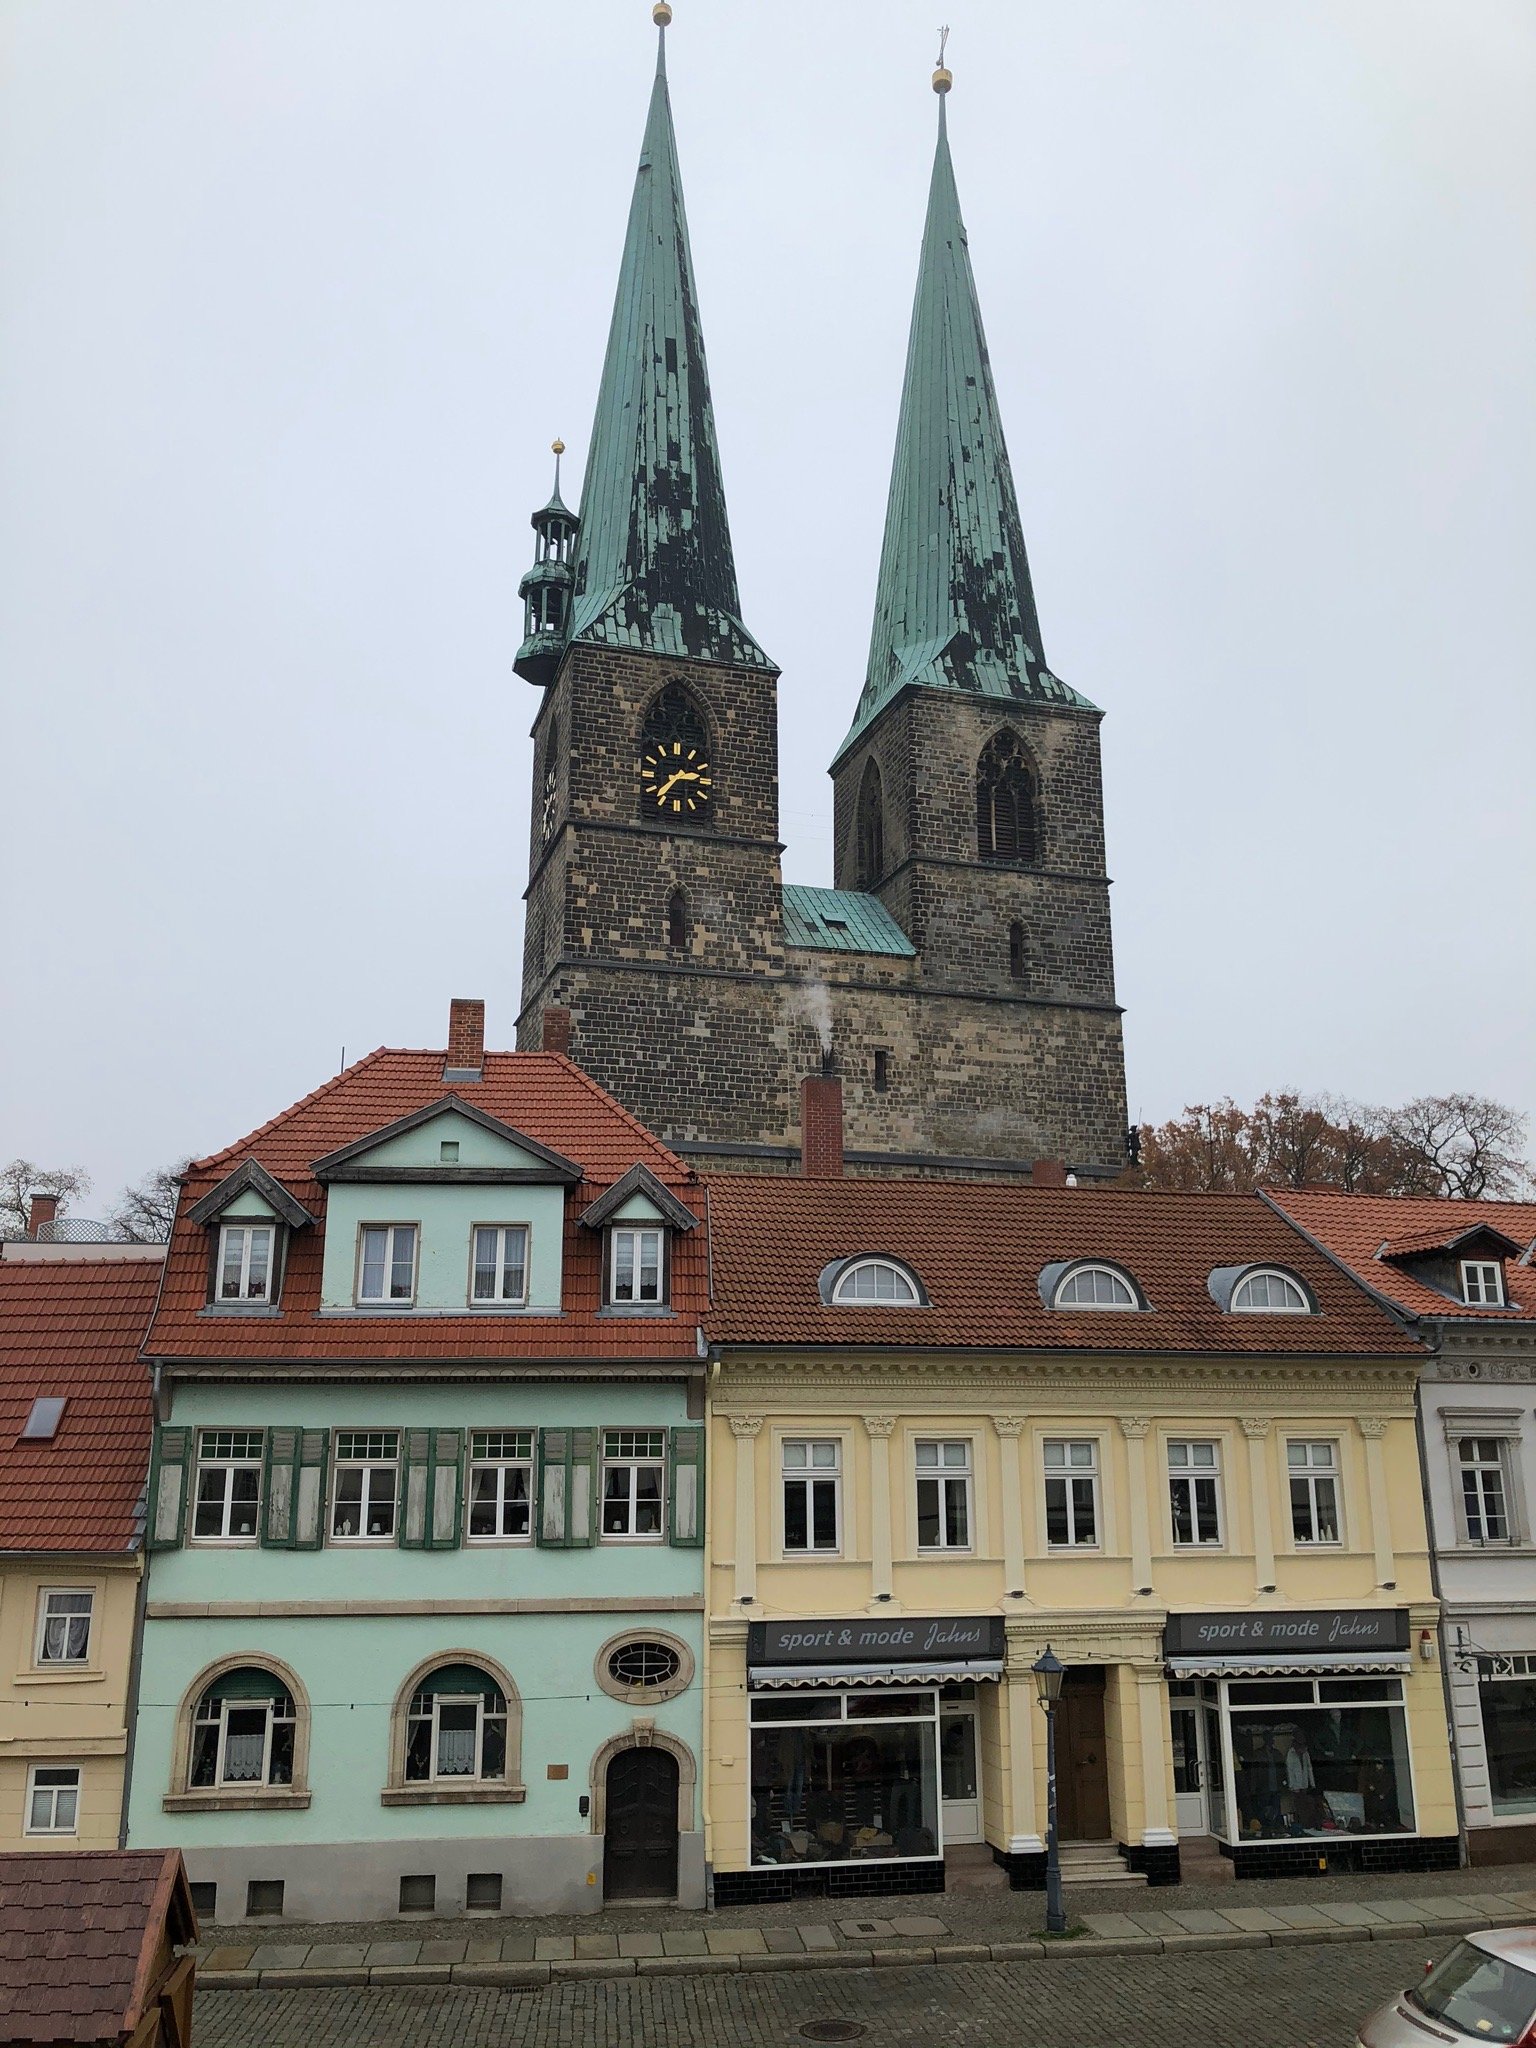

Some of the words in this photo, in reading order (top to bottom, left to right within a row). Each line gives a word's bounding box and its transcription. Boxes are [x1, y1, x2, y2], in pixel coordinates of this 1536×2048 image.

[778, 1630, 834, 1650] sport
[837, 1629, 852, 1646] &
[859, 1627, 914, 1645] mode
[924, 1623, 981, 1650] Jahns
[1198, 1621, 1248, 1642] sport
[1251, 1621, 1264, 1637] &
[1270, 1619, 1319, 1636] mode
[1328, 1615, 1380, 1642] Jahns
